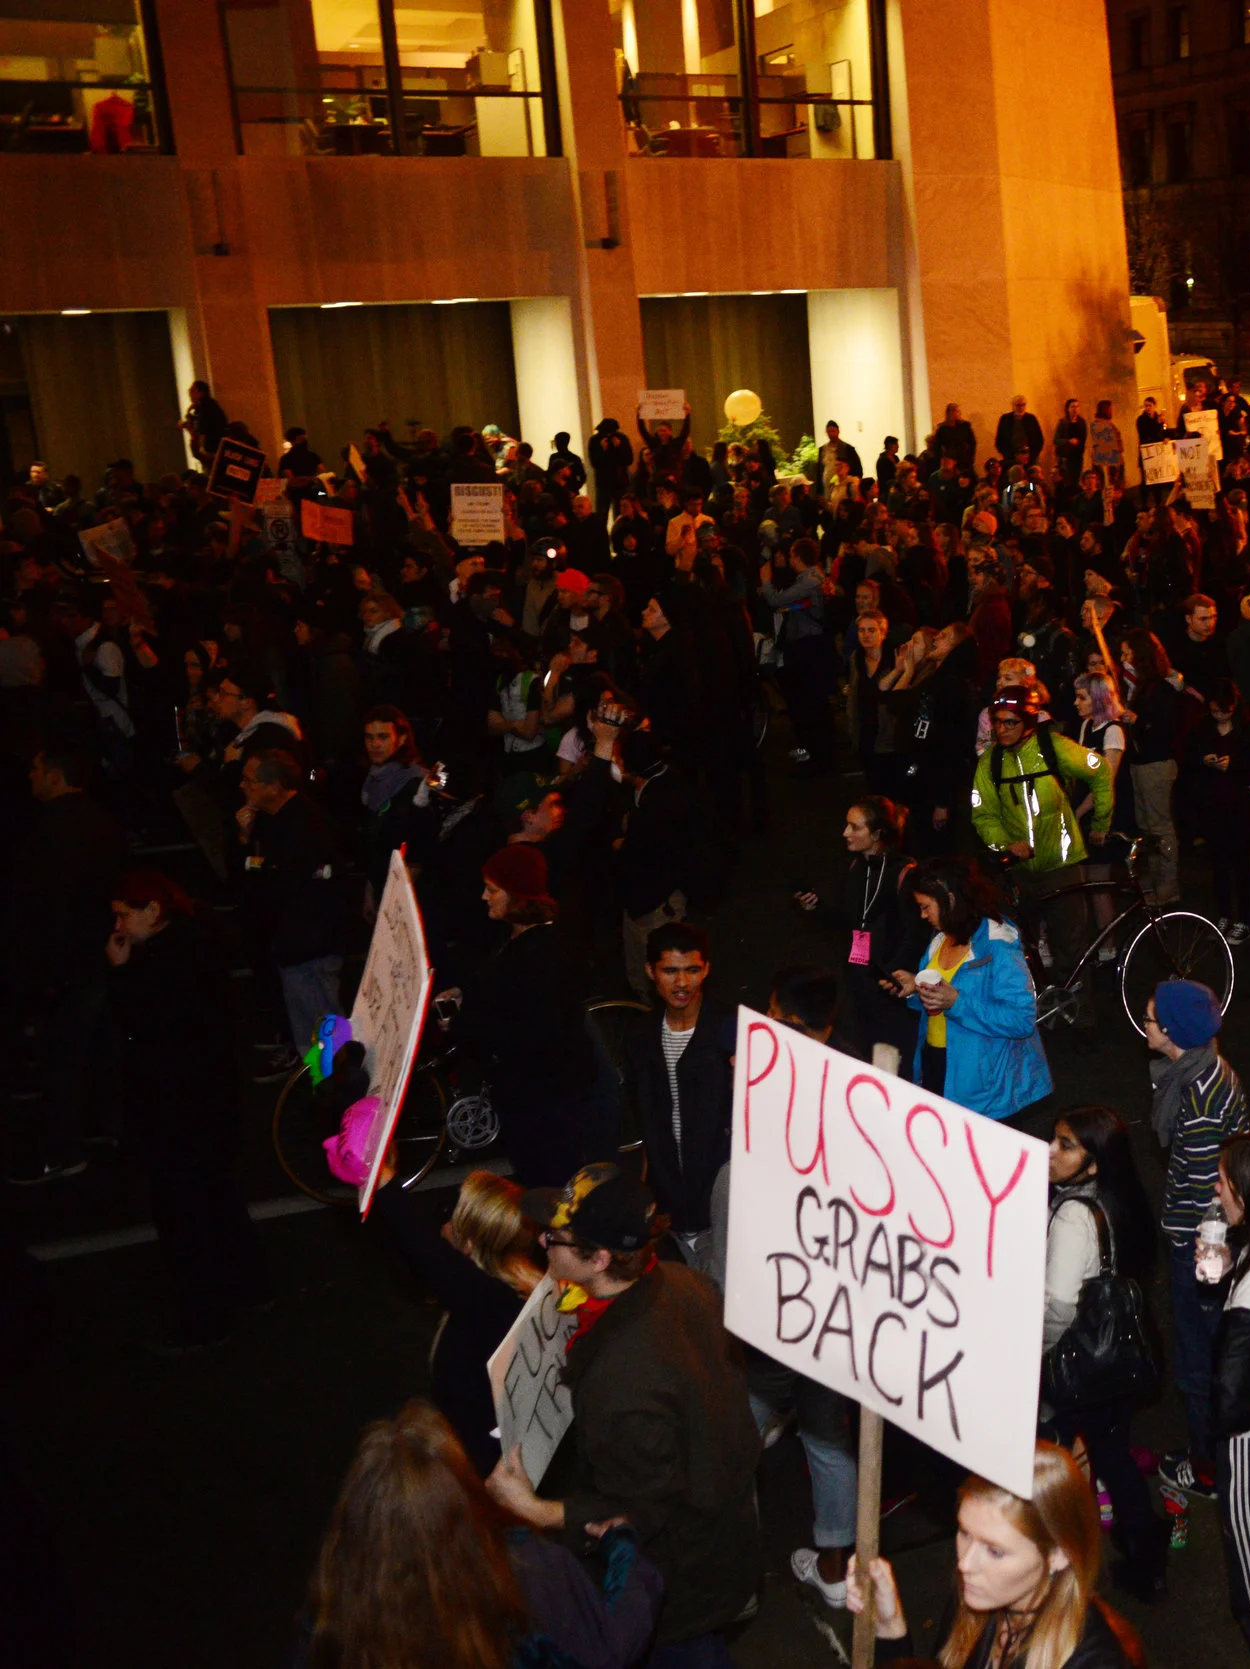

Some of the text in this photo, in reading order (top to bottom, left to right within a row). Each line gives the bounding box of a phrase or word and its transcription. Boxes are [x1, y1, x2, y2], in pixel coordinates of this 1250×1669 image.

[746, 1021, 1029, 1278] PUSSY
[796, 1185, 961, 1328] GRABS
[504, 1290, 560, 1420] FUC
[767, 1253, 965, 1442] BACK
